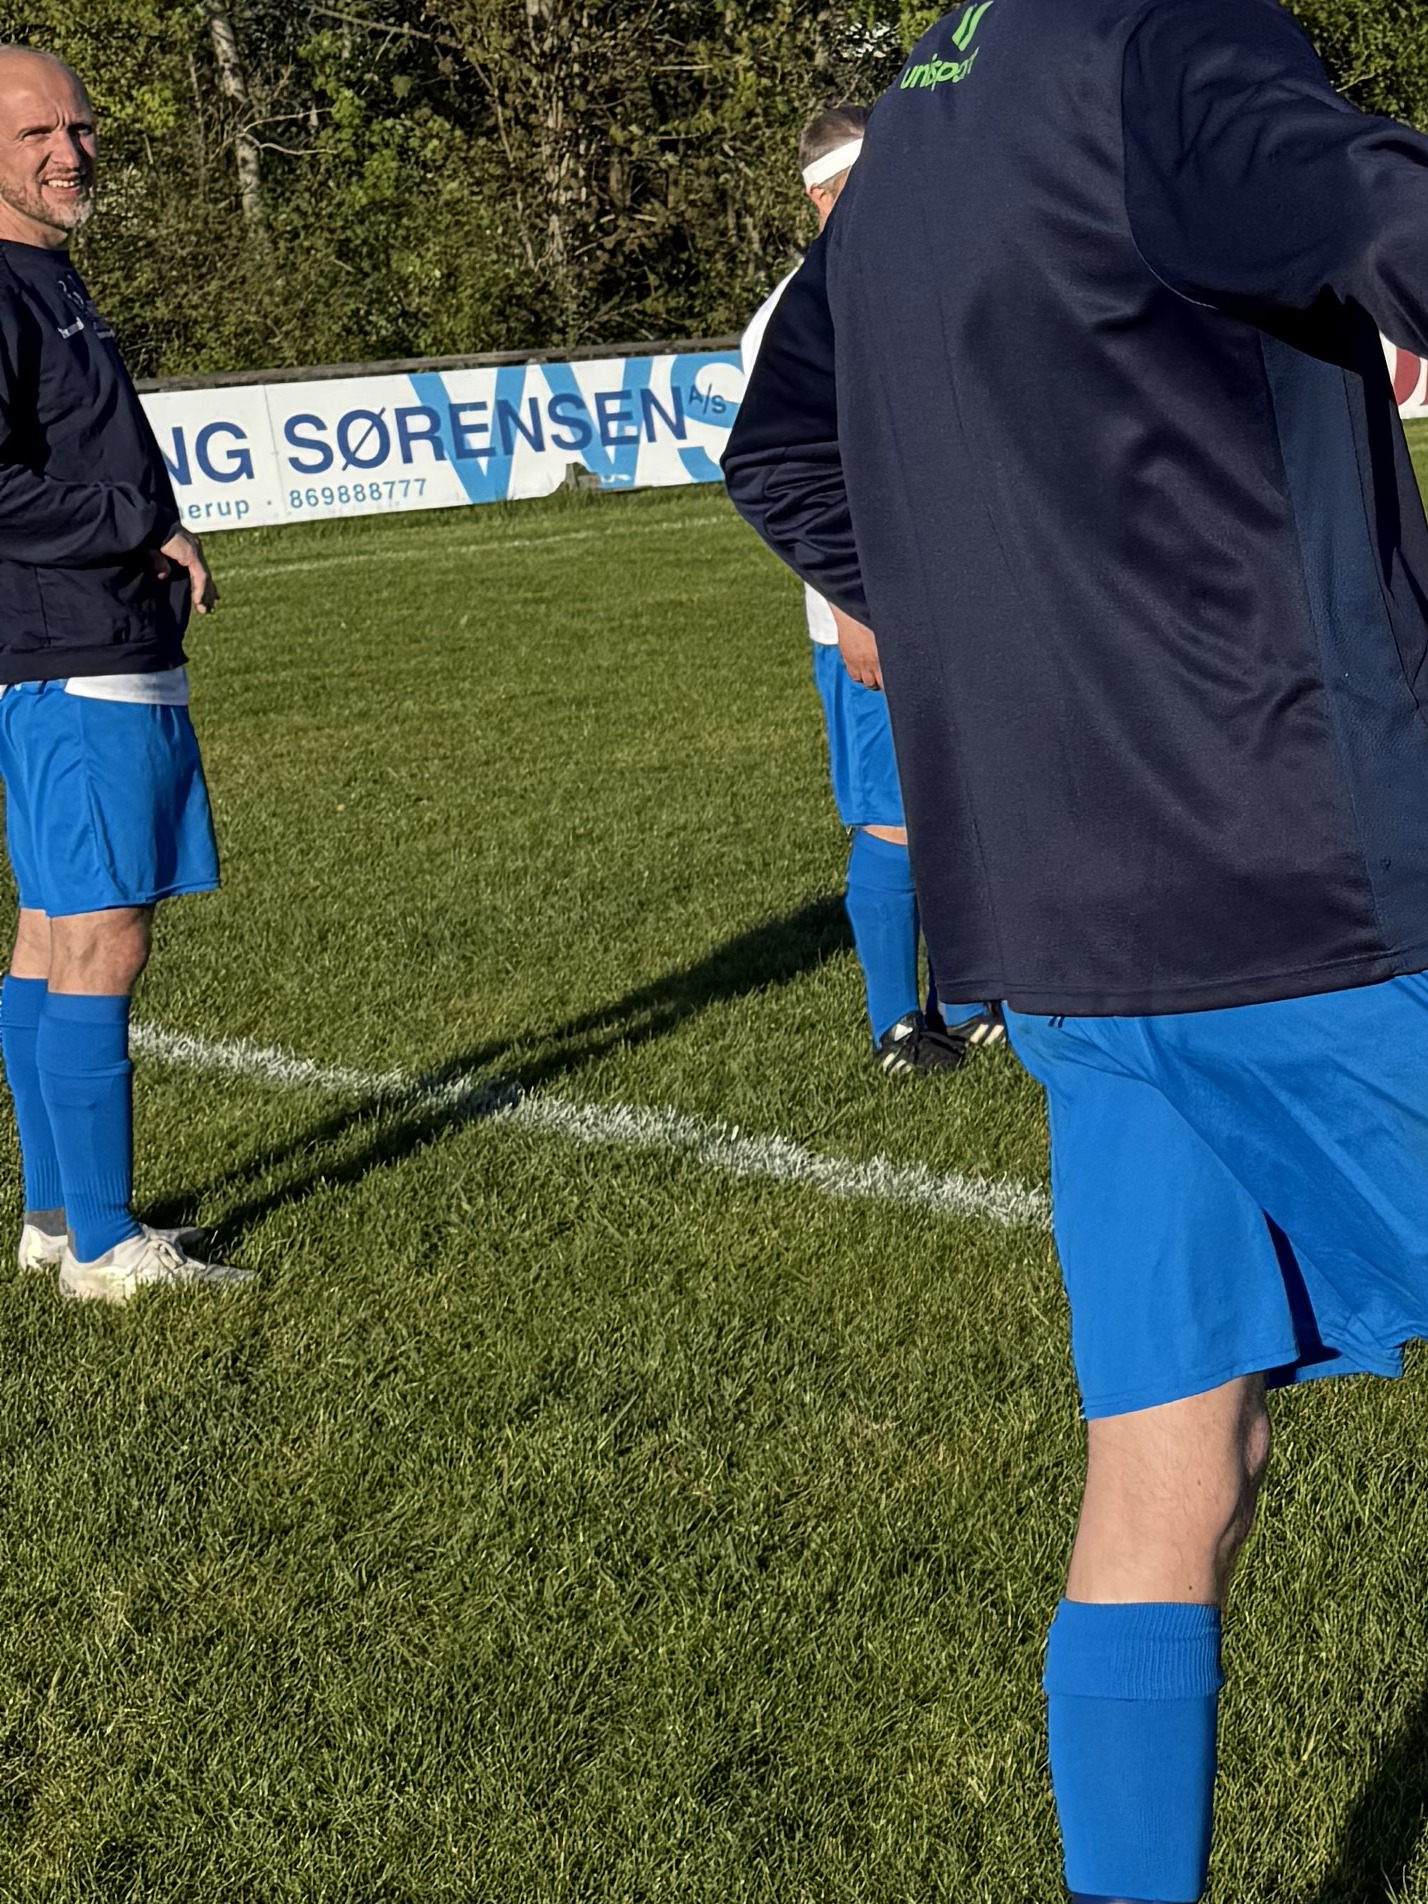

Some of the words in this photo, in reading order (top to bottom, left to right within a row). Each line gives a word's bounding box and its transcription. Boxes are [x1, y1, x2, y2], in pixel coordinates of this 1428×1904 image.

[284, 386, 688, 475] SØRENSEN
[689, 383, 727, 415] A/S
[290, 478, 427, 509] 869888777
[181, 499, 250, 520] erup
